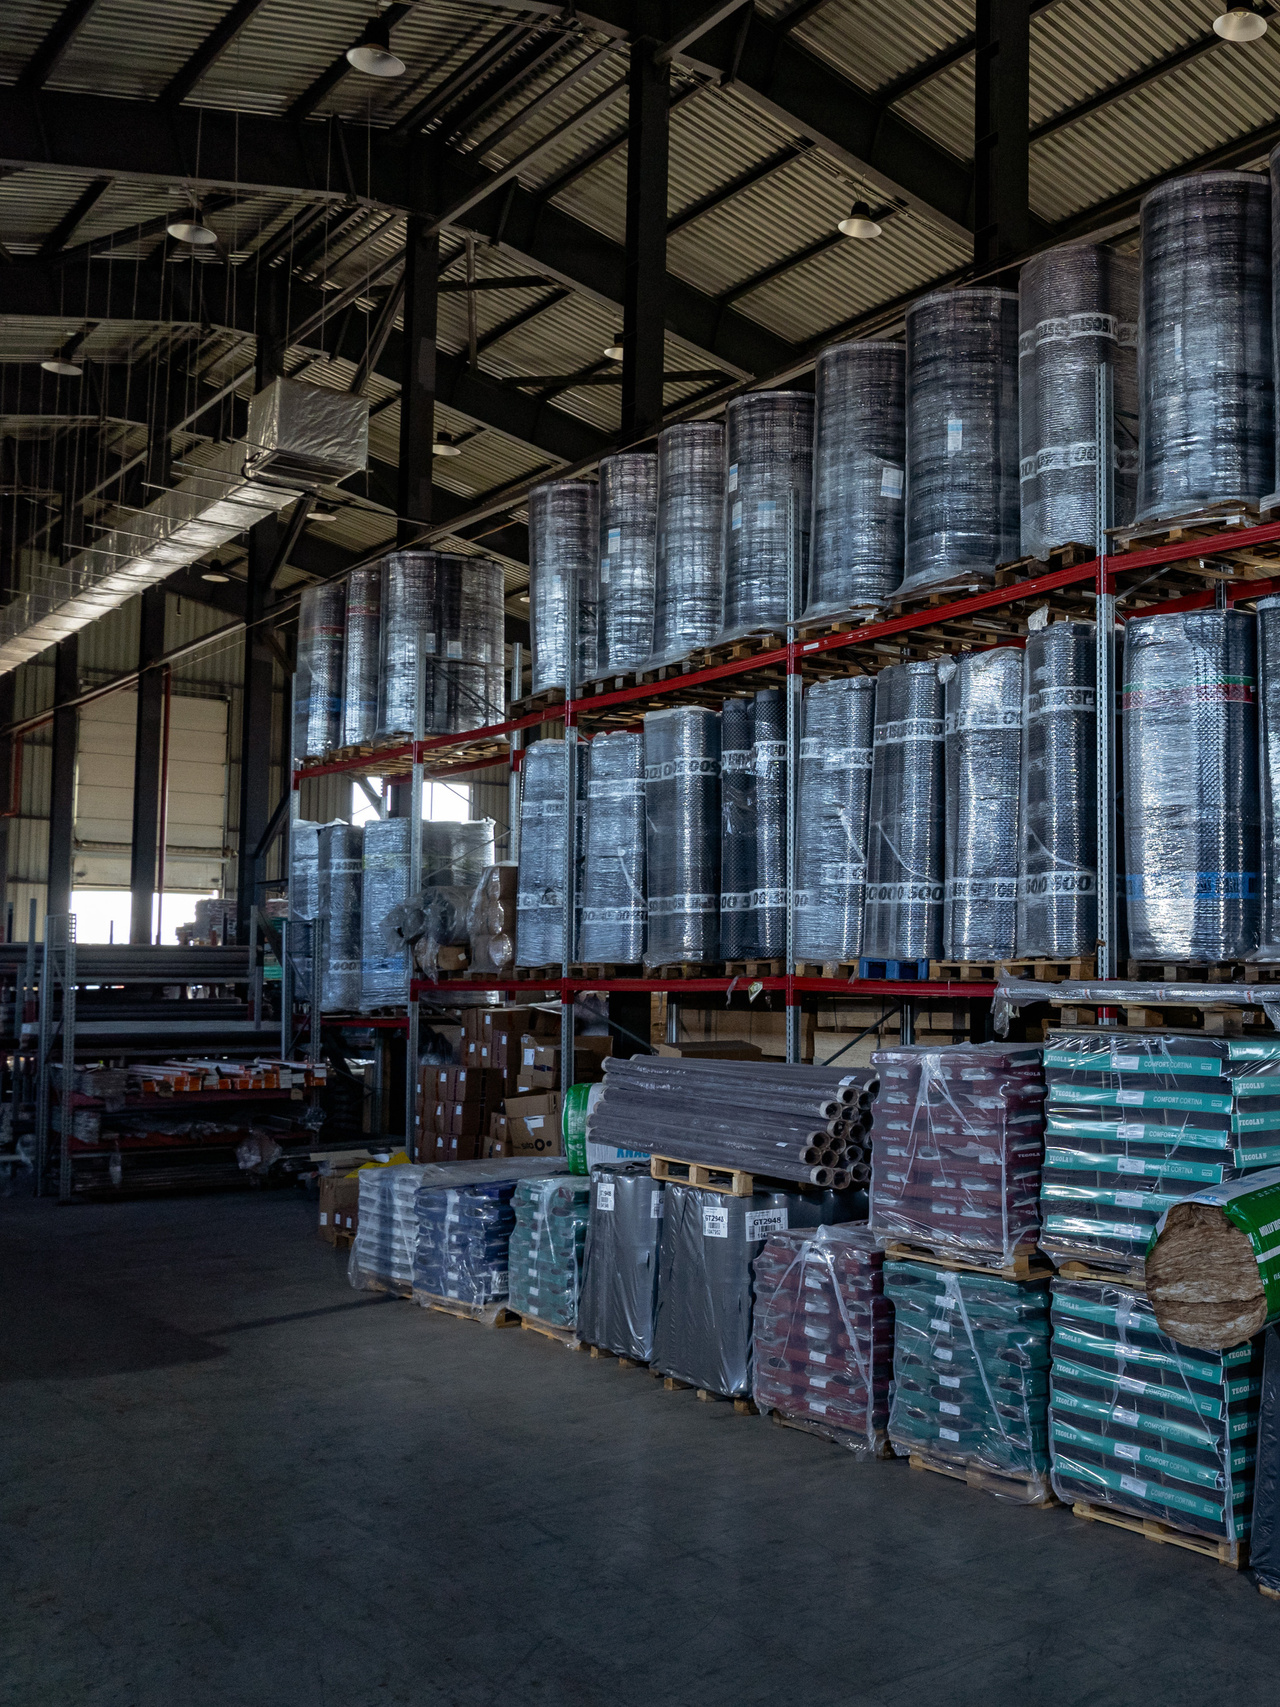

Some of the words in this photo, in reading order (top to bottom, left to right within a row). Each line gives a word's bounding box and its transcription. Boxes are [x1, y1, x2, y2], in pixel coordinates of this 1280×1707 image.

[1179, 1097, 1203, 1105] CORTINA
[616, 1148, 650, 1159] KNAU
[1241, 1153, 1264, 1161] TEGOLA
[1170, 1165, 1194, 1174] CORTINA
[753, 1216, 782, 1226] GT2948
[1228, 1349, 1252, 1360] TEGOLA
[1056, 1363, 1075, 1376] TEGOLA
[1143, 1420, 1170, 1433] COMFORT
[1144, 1454, 1170, 1468] COMFORT
[1169, 1461, 1190, 1475] CORTINA
[1150, 1488, 1175, 1501] COMFORT
[1175, 1494, 1197, 1508] CORTINA
